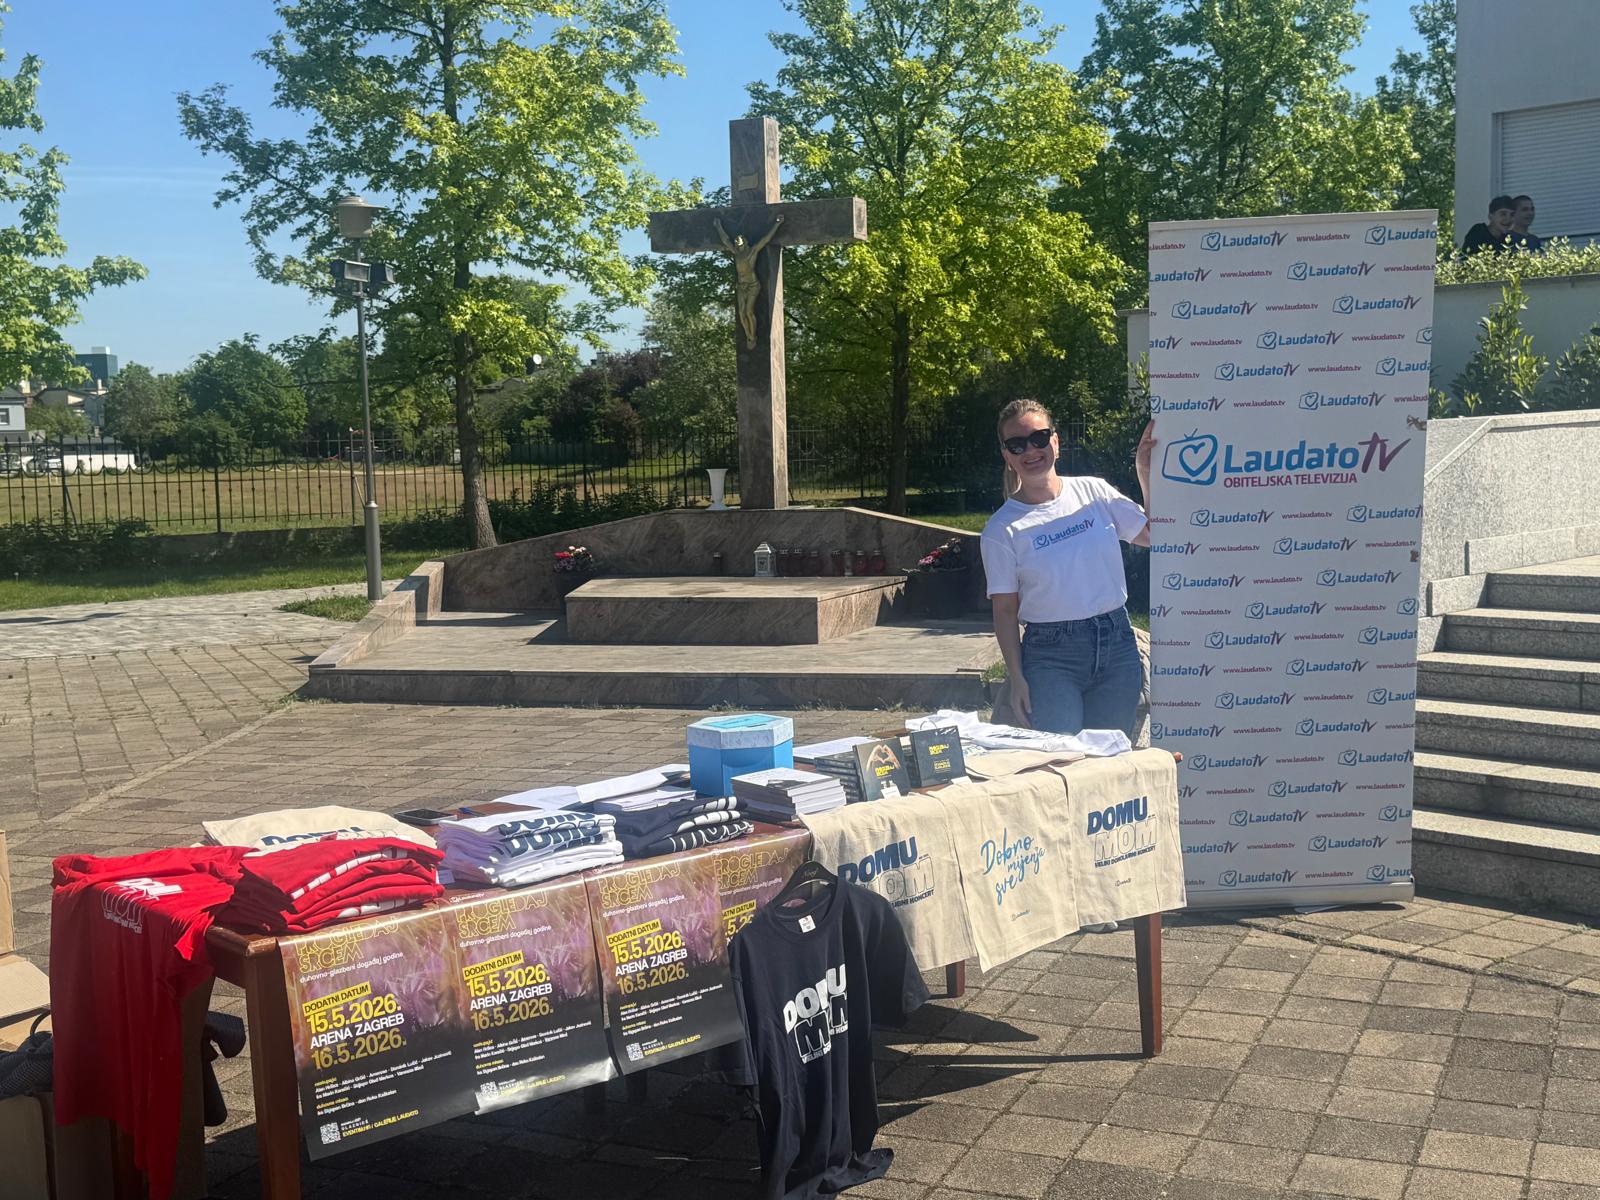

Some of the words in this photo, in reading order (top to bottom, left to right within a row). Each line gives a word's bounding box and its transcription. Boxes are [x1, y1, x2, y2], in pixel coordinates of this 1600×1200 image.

[1223, 431, 1412, 473] LaudatoTV
[1223, 474, 1292, 488] OBITELJSKA
[1294, 472, 1357, 485] TELEVIZIJA
[1365, 540, 1416, 548] www.laudato.tv
[1087, 796, 1147, 835] DOMU
[1095, 817, 1157, 861] MOM
[838, 836, 917, 884] DOMU
[856, 856, 935, 900] OM
[736, 901, 755, 914] DATUM
[608, 930, 637, 944] DODATNI
[637, 921, 660, 934] DATUM
[611, 930, 685, 964] 15.5.2026.
[464, 963, 496, 977] DODATNI
[496, 953, 522, 967] DATUM
[615, 960, 649, 977] ARENA
[650, 948, 688, 968] ZAGREB
[616, 962, 689, 995] 16.5.2026.
[466, 964, 551, 998] 15.5.2026.
[470, 995, 508, 1011] ARENA
[509, 983, 553, 1002] ZAGREB
[304, 996, 340, 1013] DODATNI
[341, 985, 368, 1001] DATUM
[306, 993, 401, 1034] 15.5.2026.
[470, 997, 554, 1032] 16.5.2026.
[310, 1026, 353, 1049] ARENA
[355, 1013, 405, 1036] ZAGREB
[311, 1027, 407, 1070] 16.5.2026.
